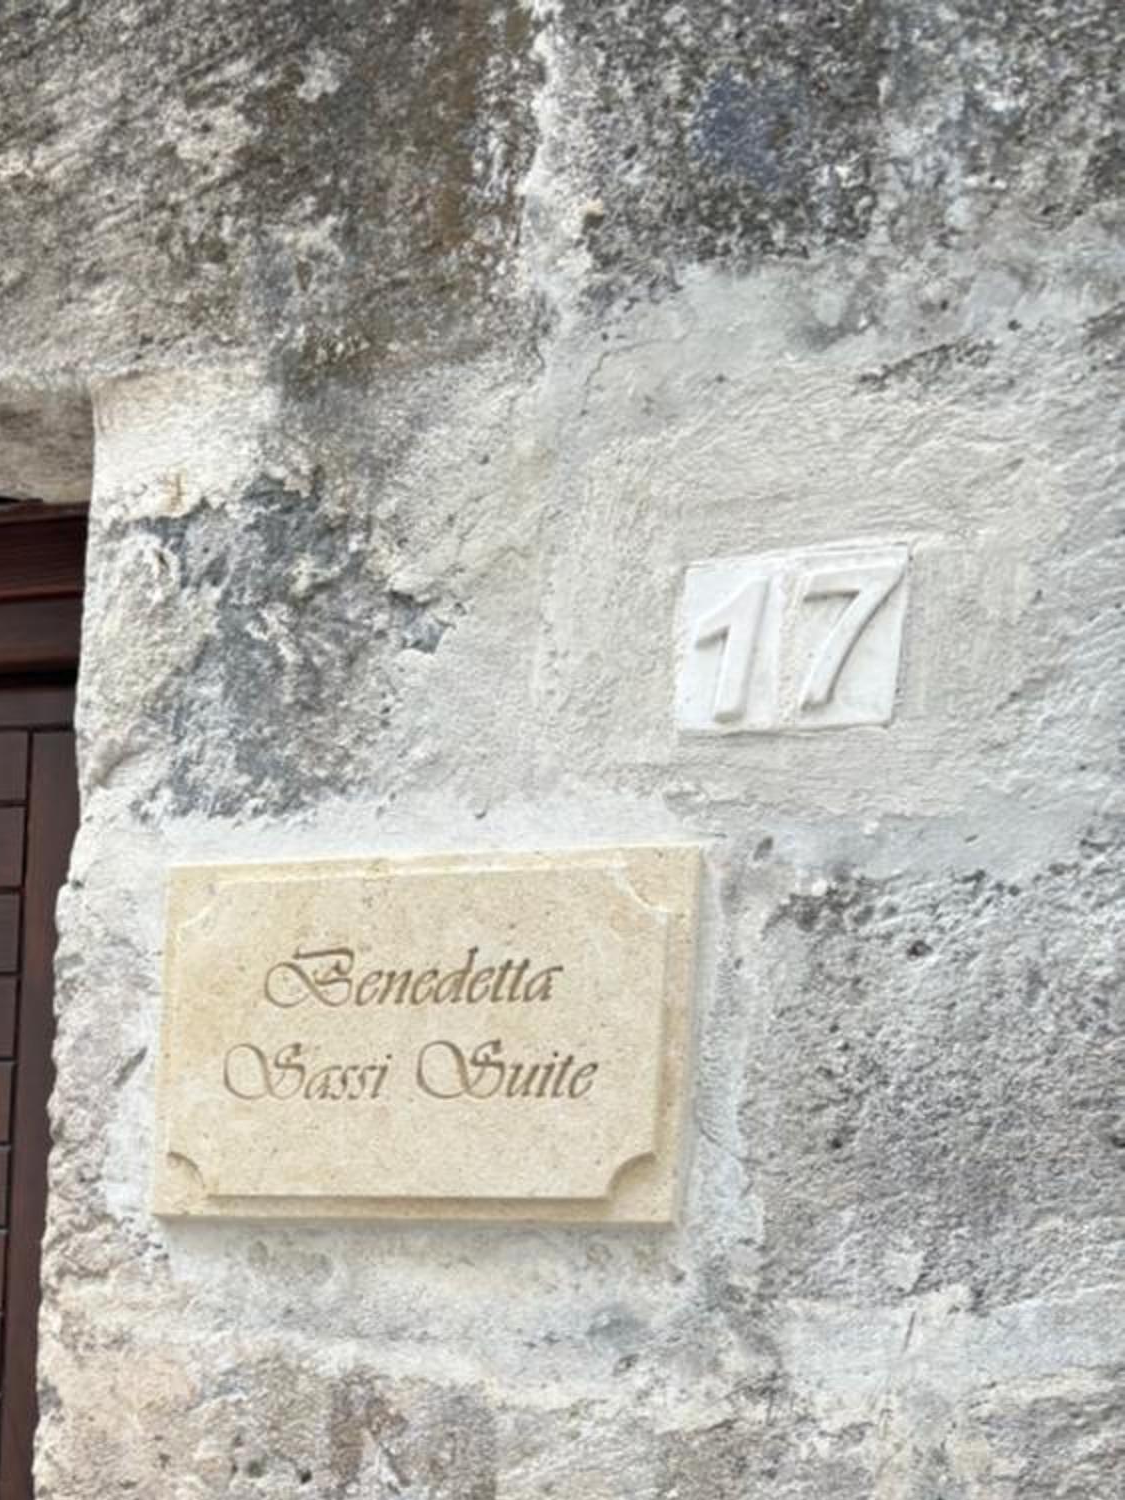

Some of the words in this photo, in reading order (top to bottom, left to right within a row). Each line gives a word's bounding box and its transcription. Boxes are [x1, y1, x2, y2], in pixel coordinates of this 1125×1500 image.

[693, 565, 905, 723] 17
[263, 946, 564, 1009] Benedetta
[222, 1042, 394, 1101] Sassi
[415, 1039, 599, 1101] Suite
